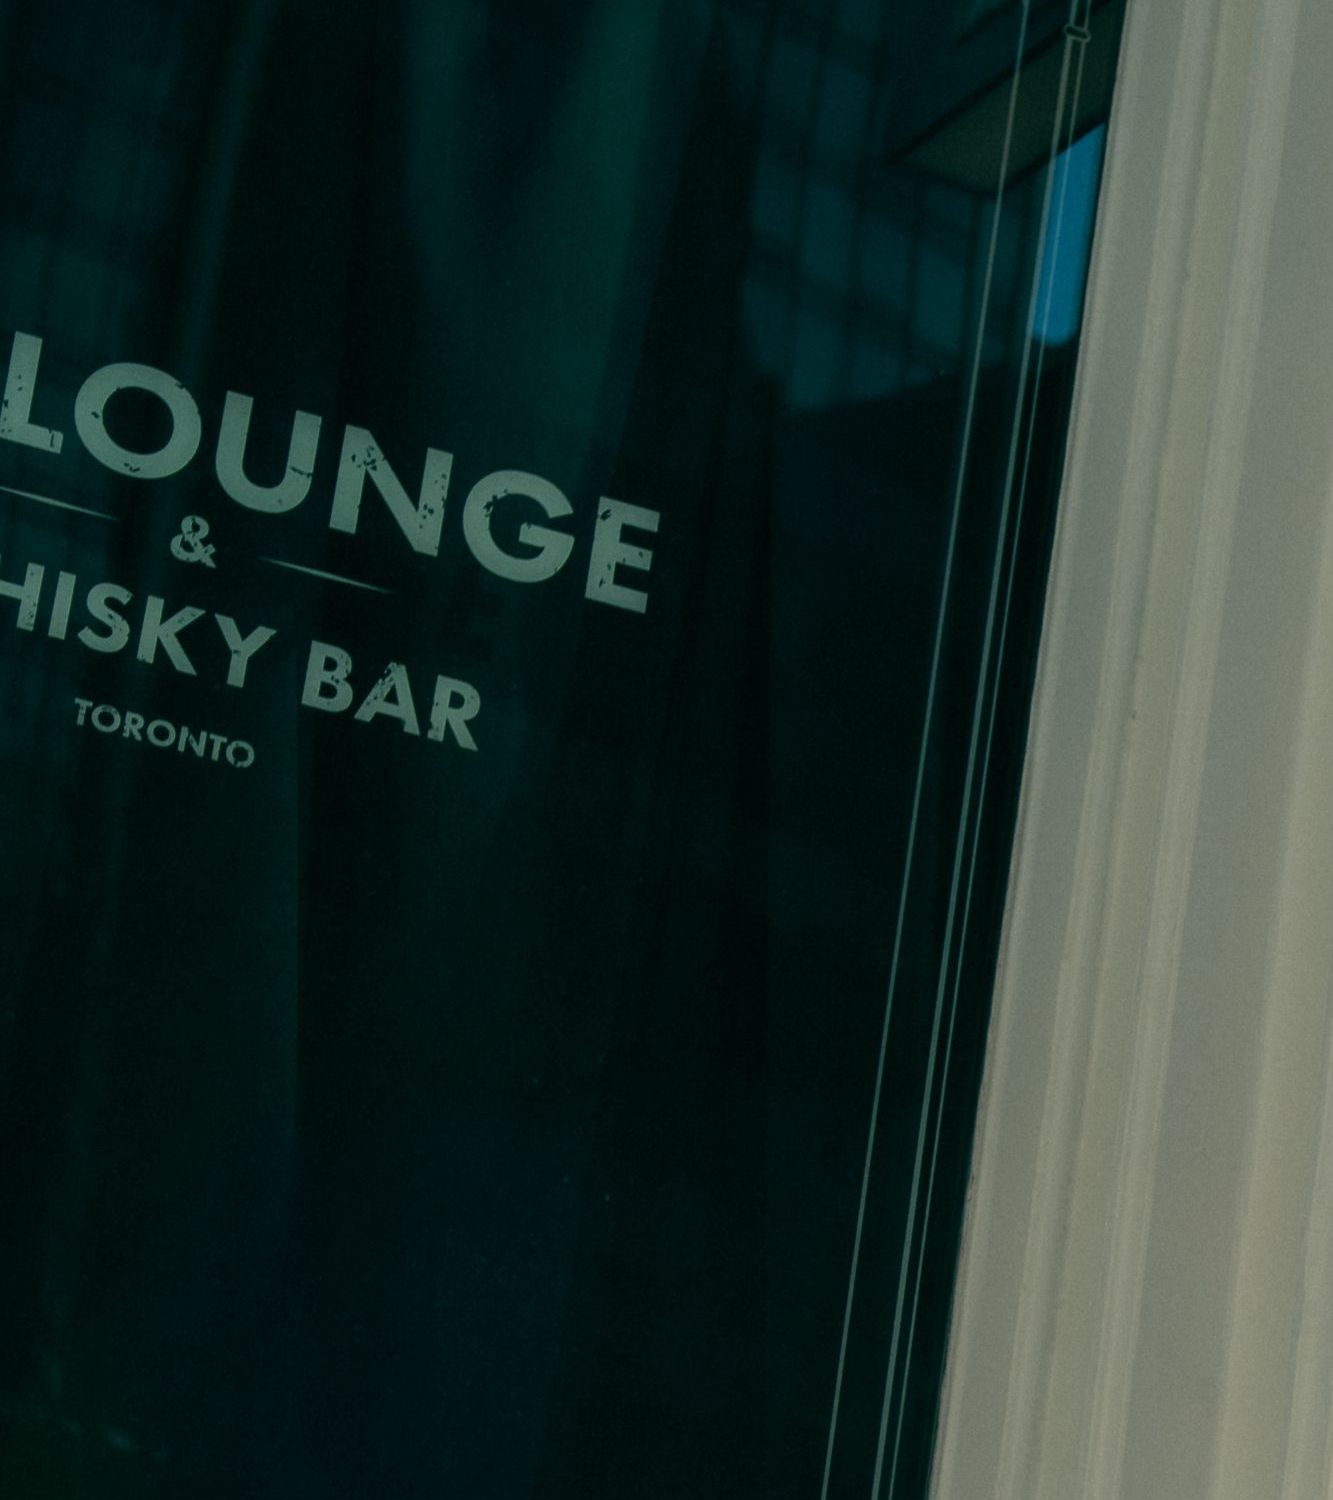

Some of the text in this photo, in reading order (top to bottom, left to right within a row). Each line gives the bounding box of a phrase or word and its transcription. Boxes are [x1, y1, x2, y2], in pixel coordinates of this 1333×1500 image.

[0, 331, 660, 613] LOUNGE
[170, 515, 216, 569] &
[74, 698, 255, 768] TORONTO
[301, 641, 481, 752] BAR
